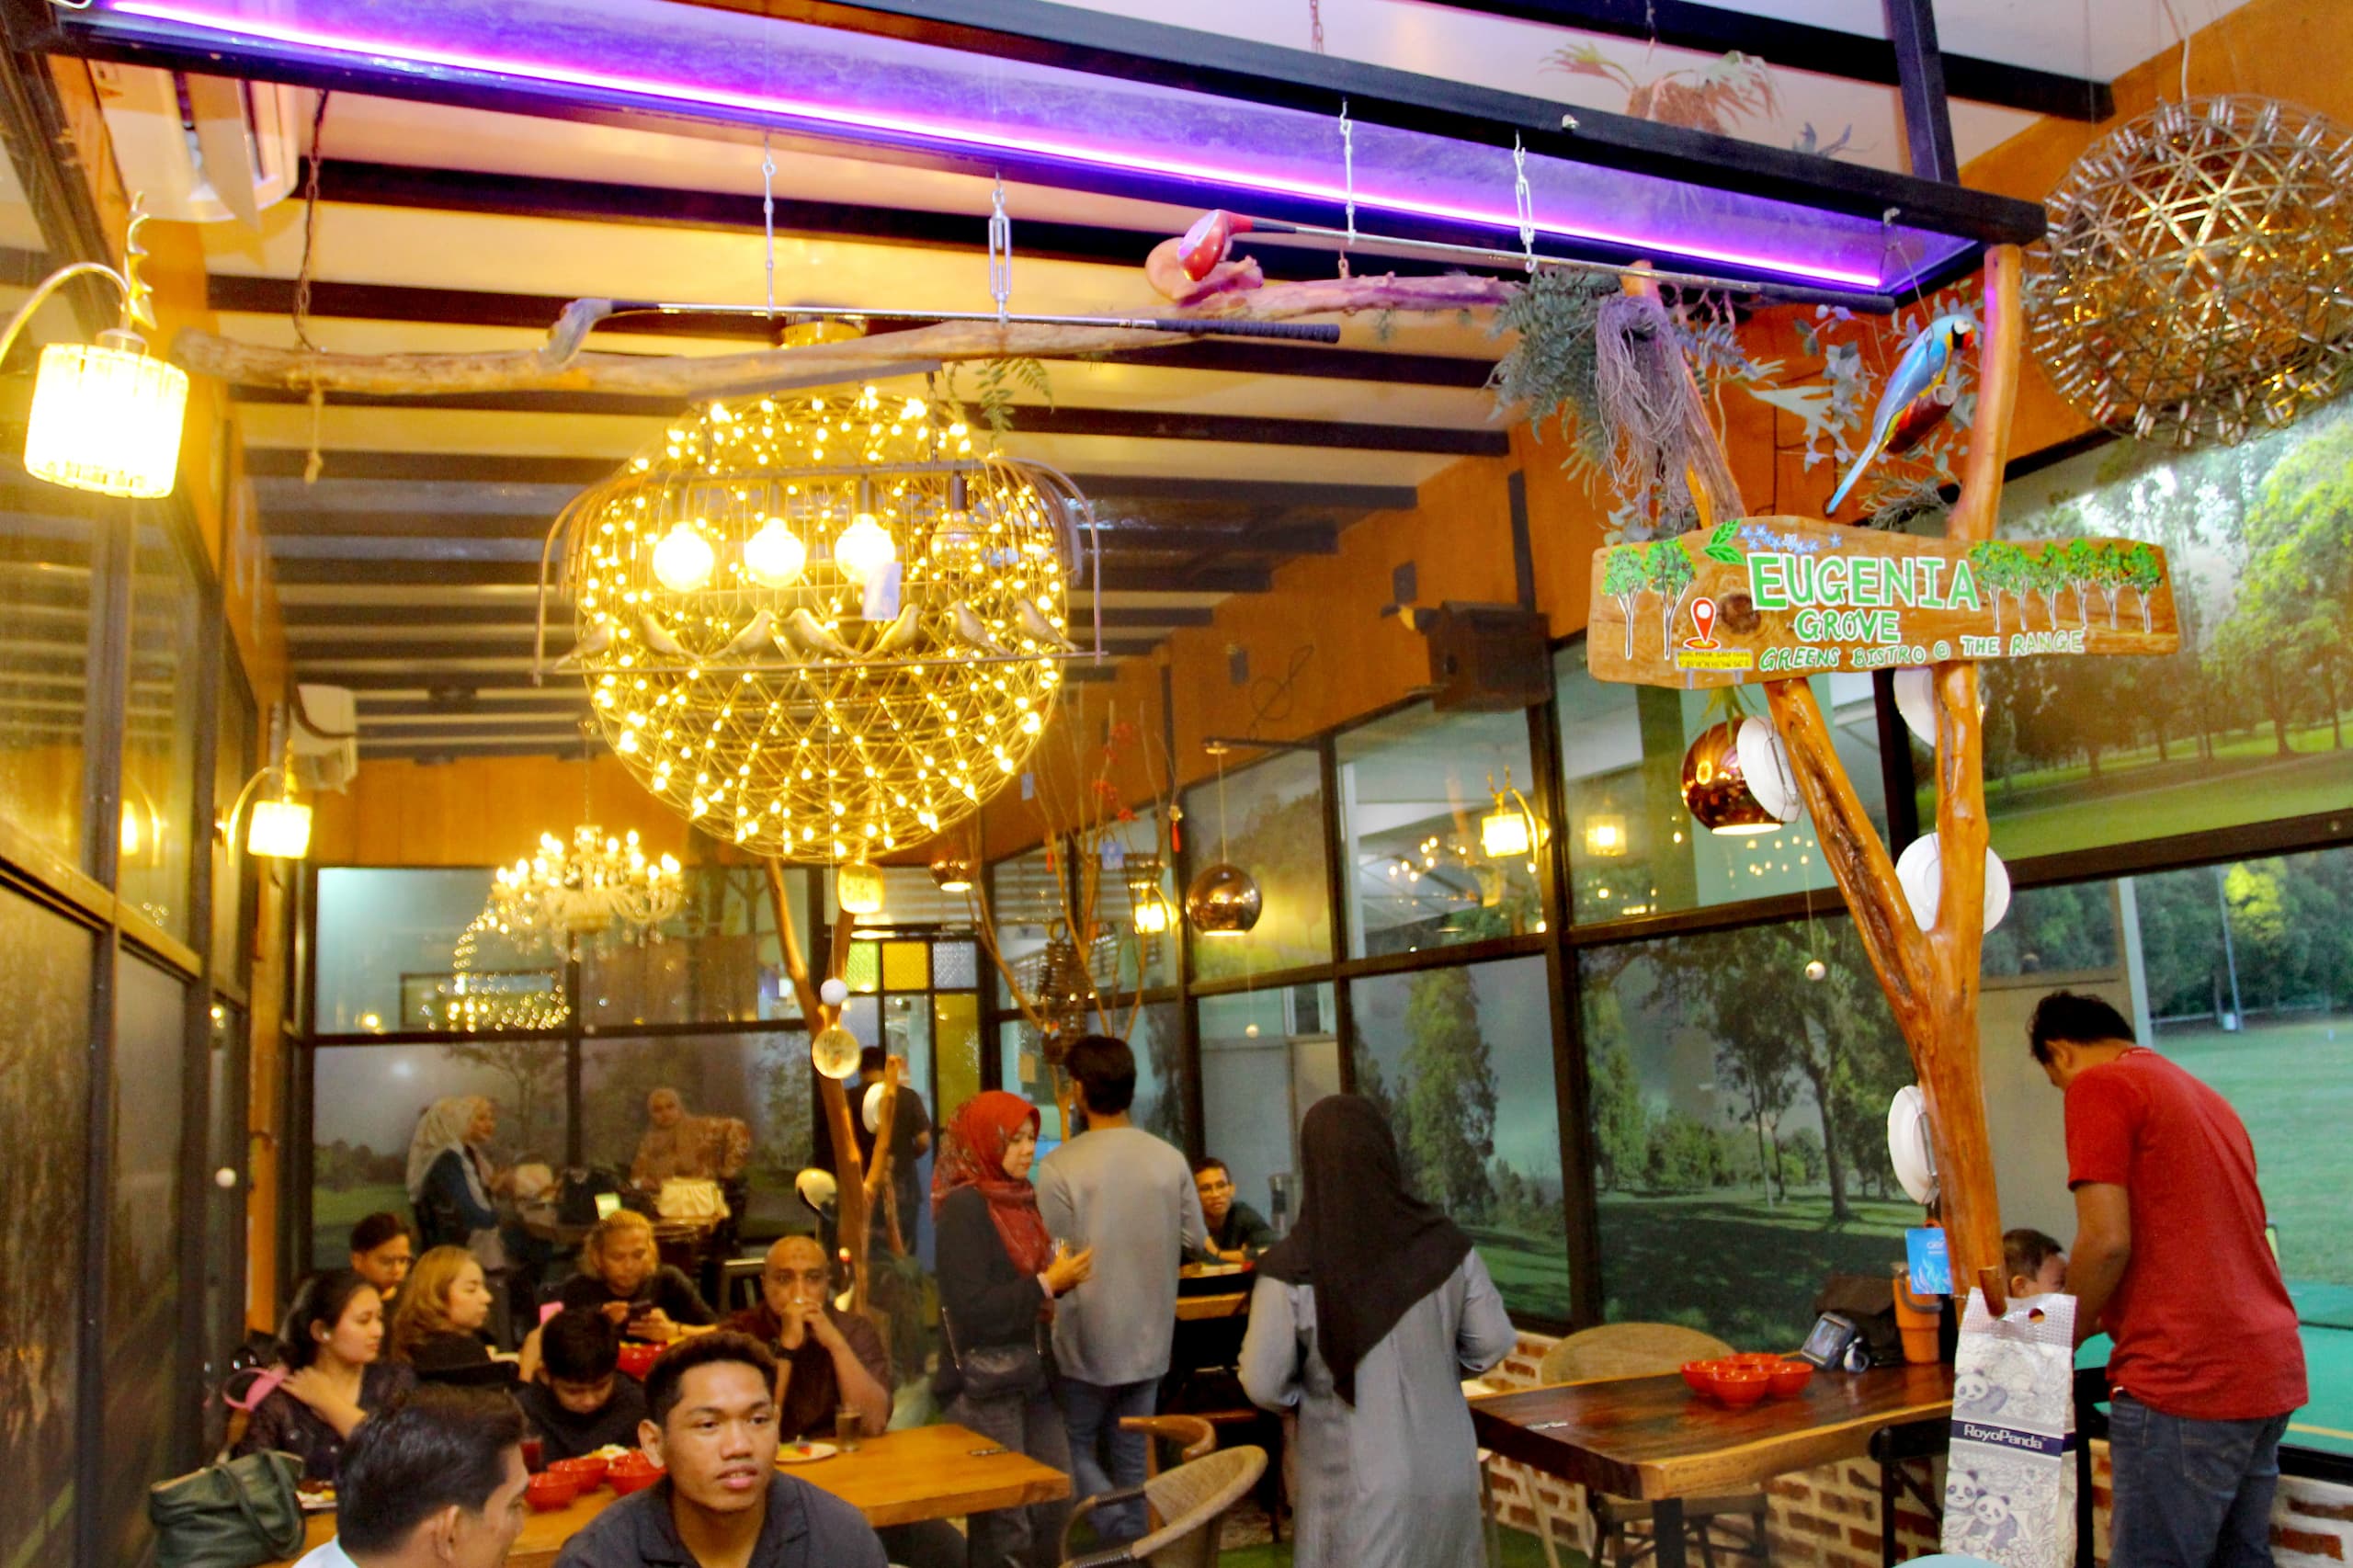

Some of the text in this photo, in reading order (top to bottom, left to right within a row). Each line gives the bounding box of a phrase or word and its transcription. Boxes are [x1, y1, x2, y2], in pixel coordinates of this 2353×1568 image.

[1747, 553, 1980, 610] EUGENIA
[1794, 608, 1901, 642] GROVE
[1759, 630, 2085, 671] GREENS BISTRO @ THE RANGE
[1963, 1424, 2042, 1449] RoyoPanda
